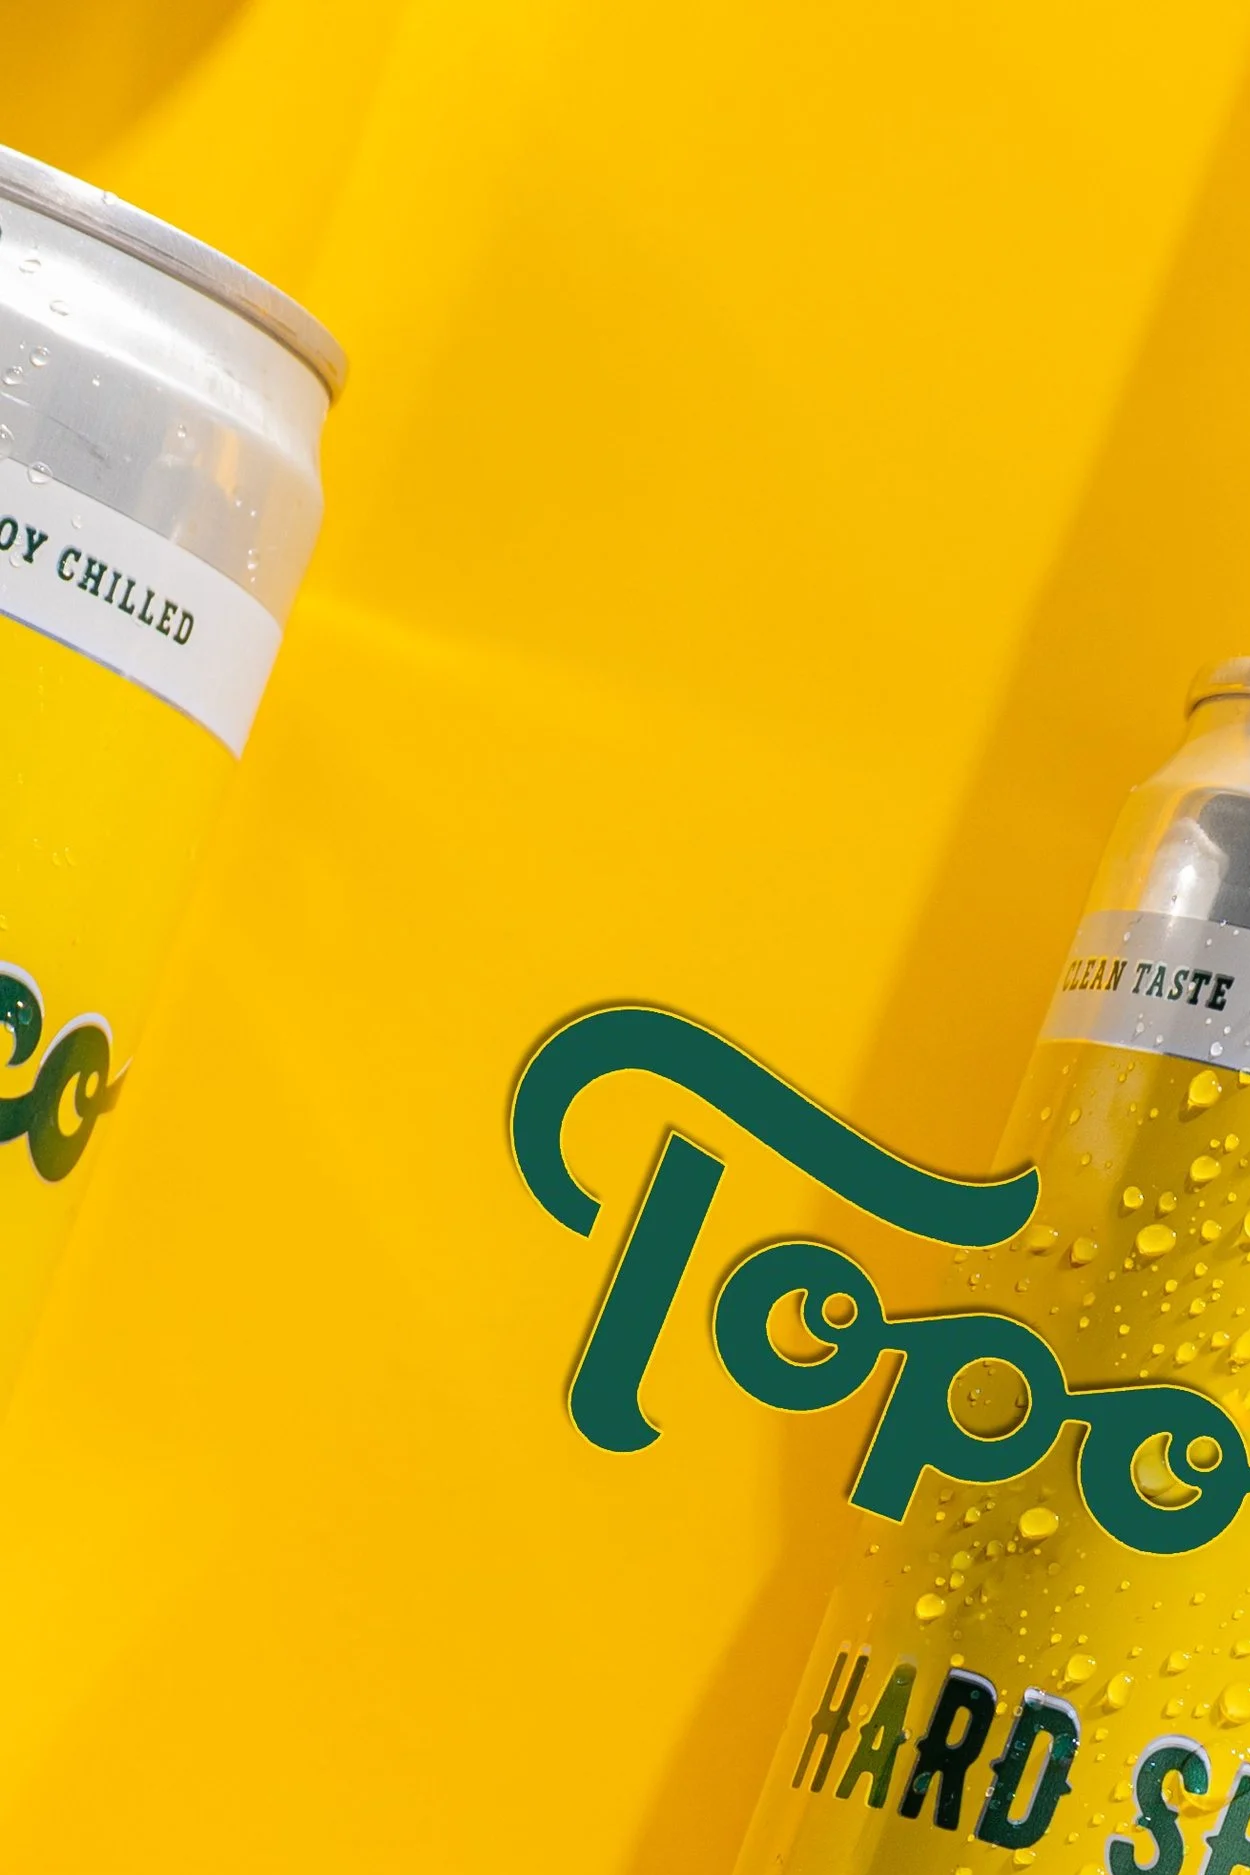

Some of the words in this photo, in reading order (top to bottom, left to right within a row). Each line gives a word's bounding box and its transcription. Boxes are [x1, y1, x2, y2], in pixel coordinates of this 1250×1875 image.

[57, 545, 194, 645] CHILLED
[1062, 957, 1128, 992] CLEAN
[1131, 962, 1235, 1011] TASTE
[792, 1641, 1082, 1851] HARD
